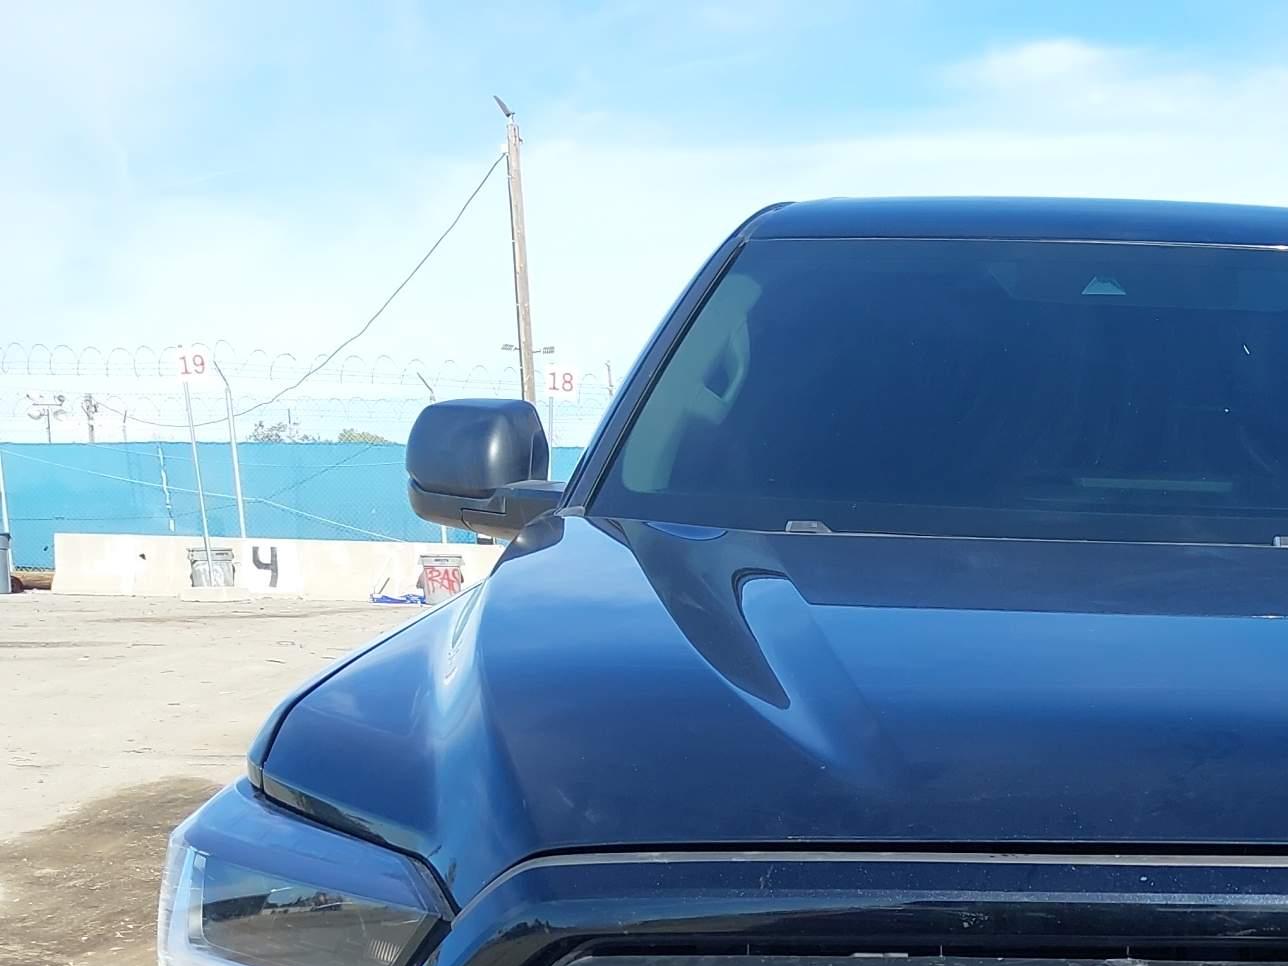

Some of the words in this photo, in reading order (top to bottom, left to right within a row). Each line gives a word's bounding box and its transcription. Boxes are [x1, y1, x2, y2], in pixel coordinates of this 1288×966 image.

[179, 354, 205, 375] 19
[548, 371, 574, 392] 18
[252, 546, 278, 588] 4
